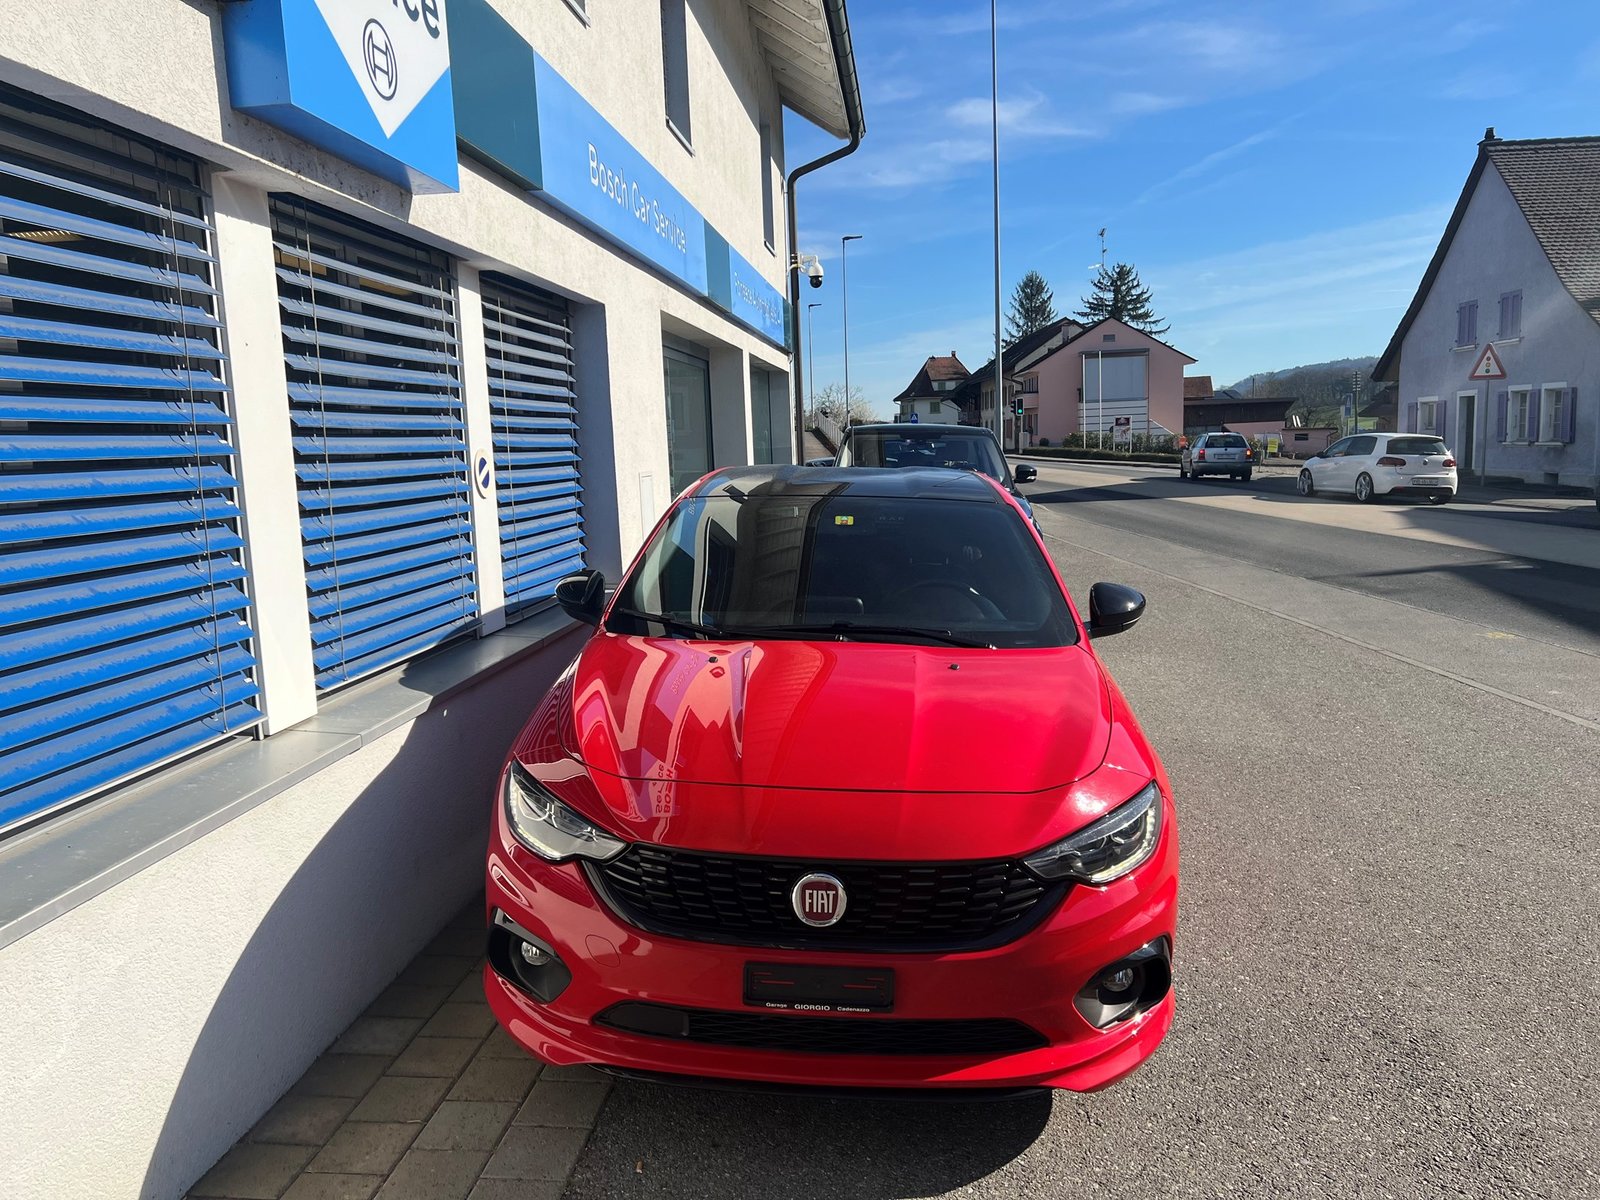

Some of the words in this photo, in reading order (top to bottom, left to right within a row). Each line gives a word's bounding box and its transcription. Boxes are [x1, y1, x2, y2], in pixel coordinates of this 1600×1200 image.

[588, 142, 629, 211] Bosch
[632, 181, 651, 226] Car
[653, 199, 687, 254] Service
[805, 889, 836, 914] FIAT
[794, 1003, 831, 1011] GIORGIO
